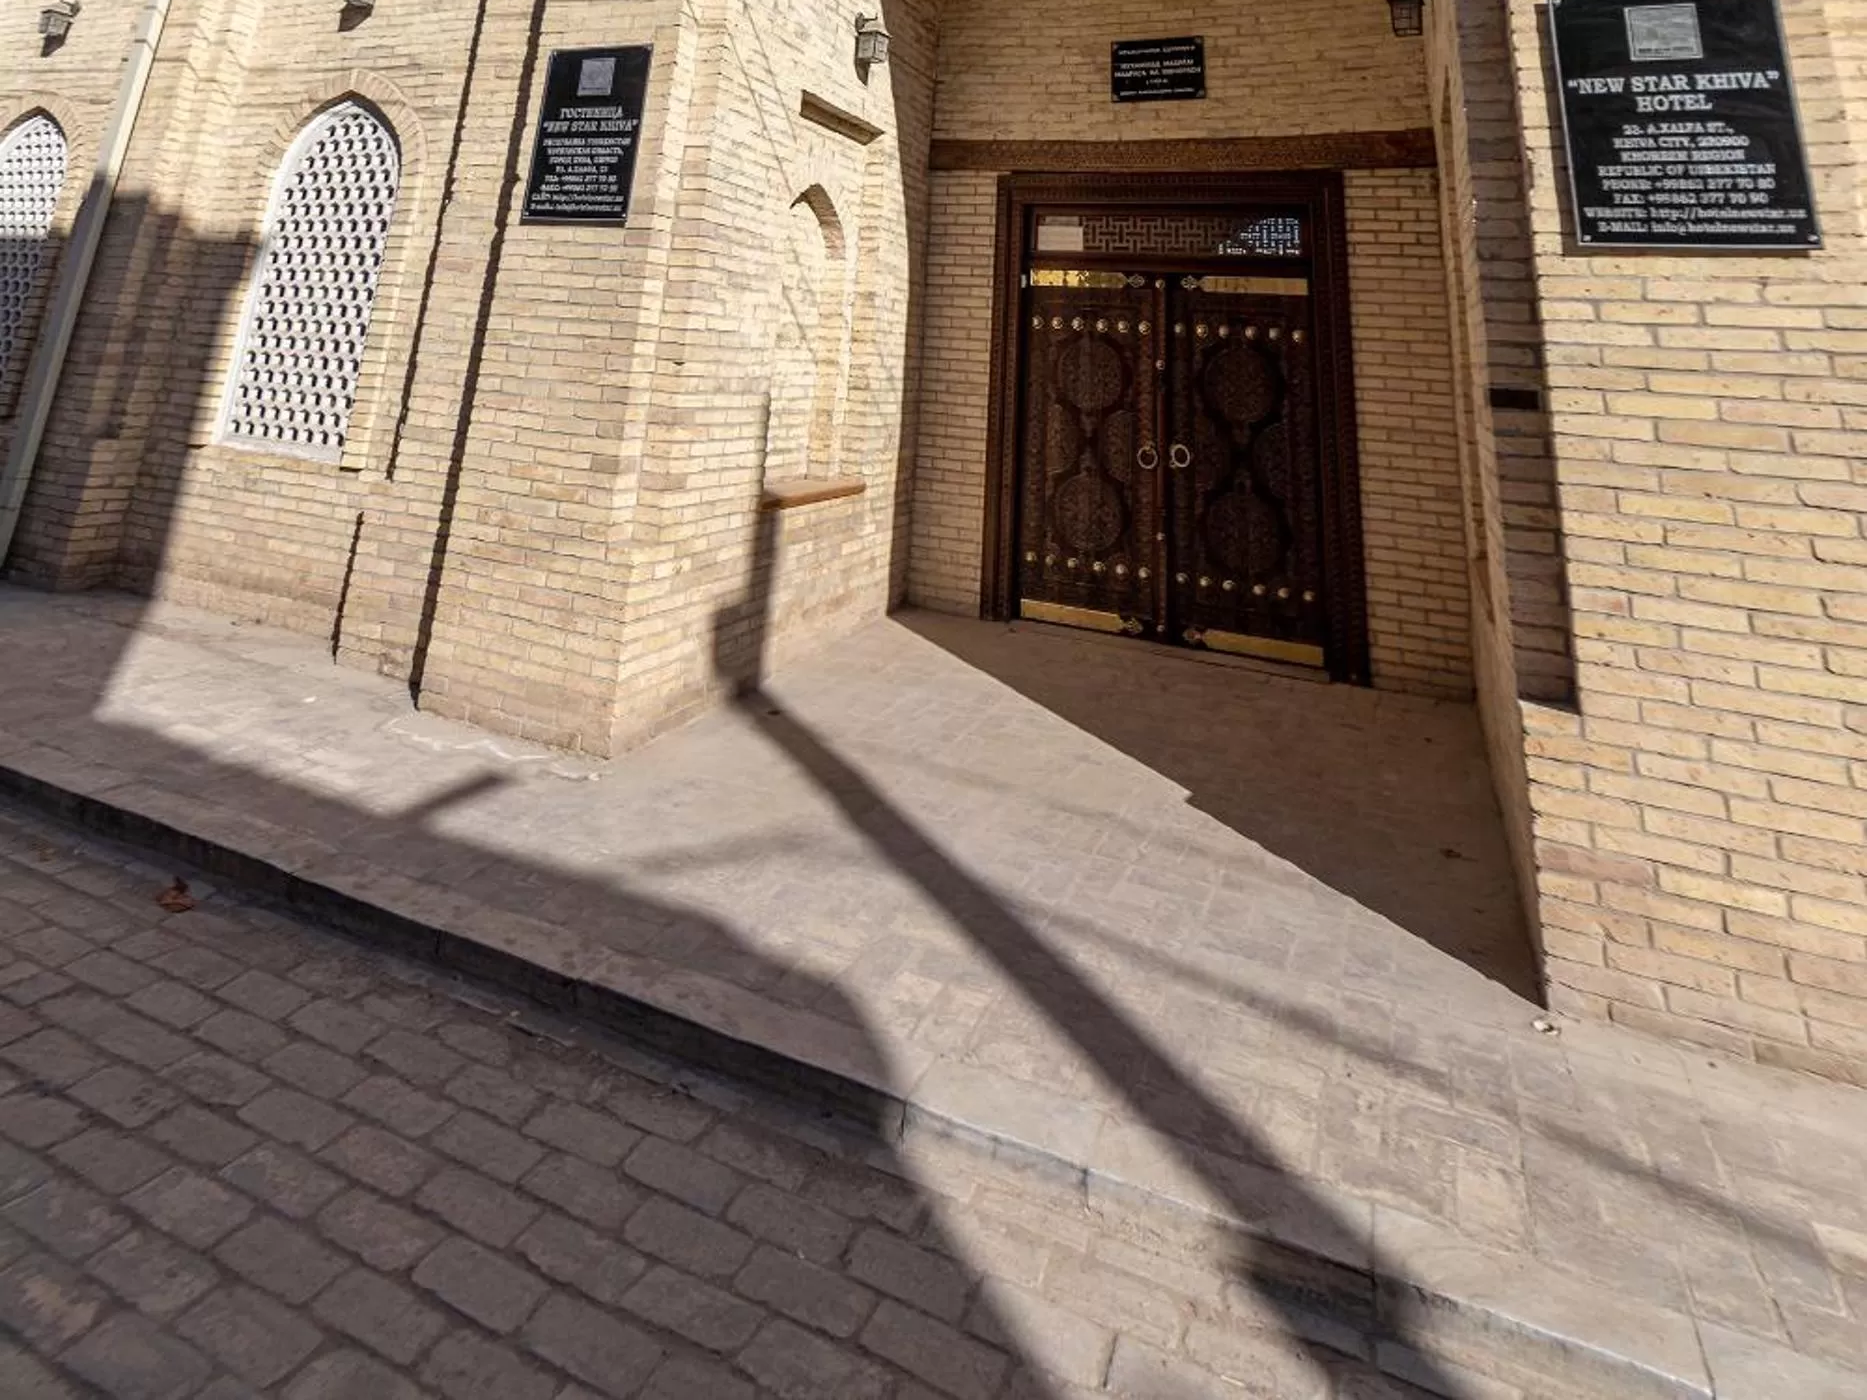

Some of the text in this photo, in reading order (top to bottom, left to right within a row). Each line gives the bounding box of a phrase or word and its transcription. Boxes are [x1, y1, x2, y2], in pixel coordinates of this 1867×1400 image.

[1630, 73, 1690, 93] STAR
[1635, 94, 1713, 113] HOTEL
[1665, 164, 1685, 176] OF
